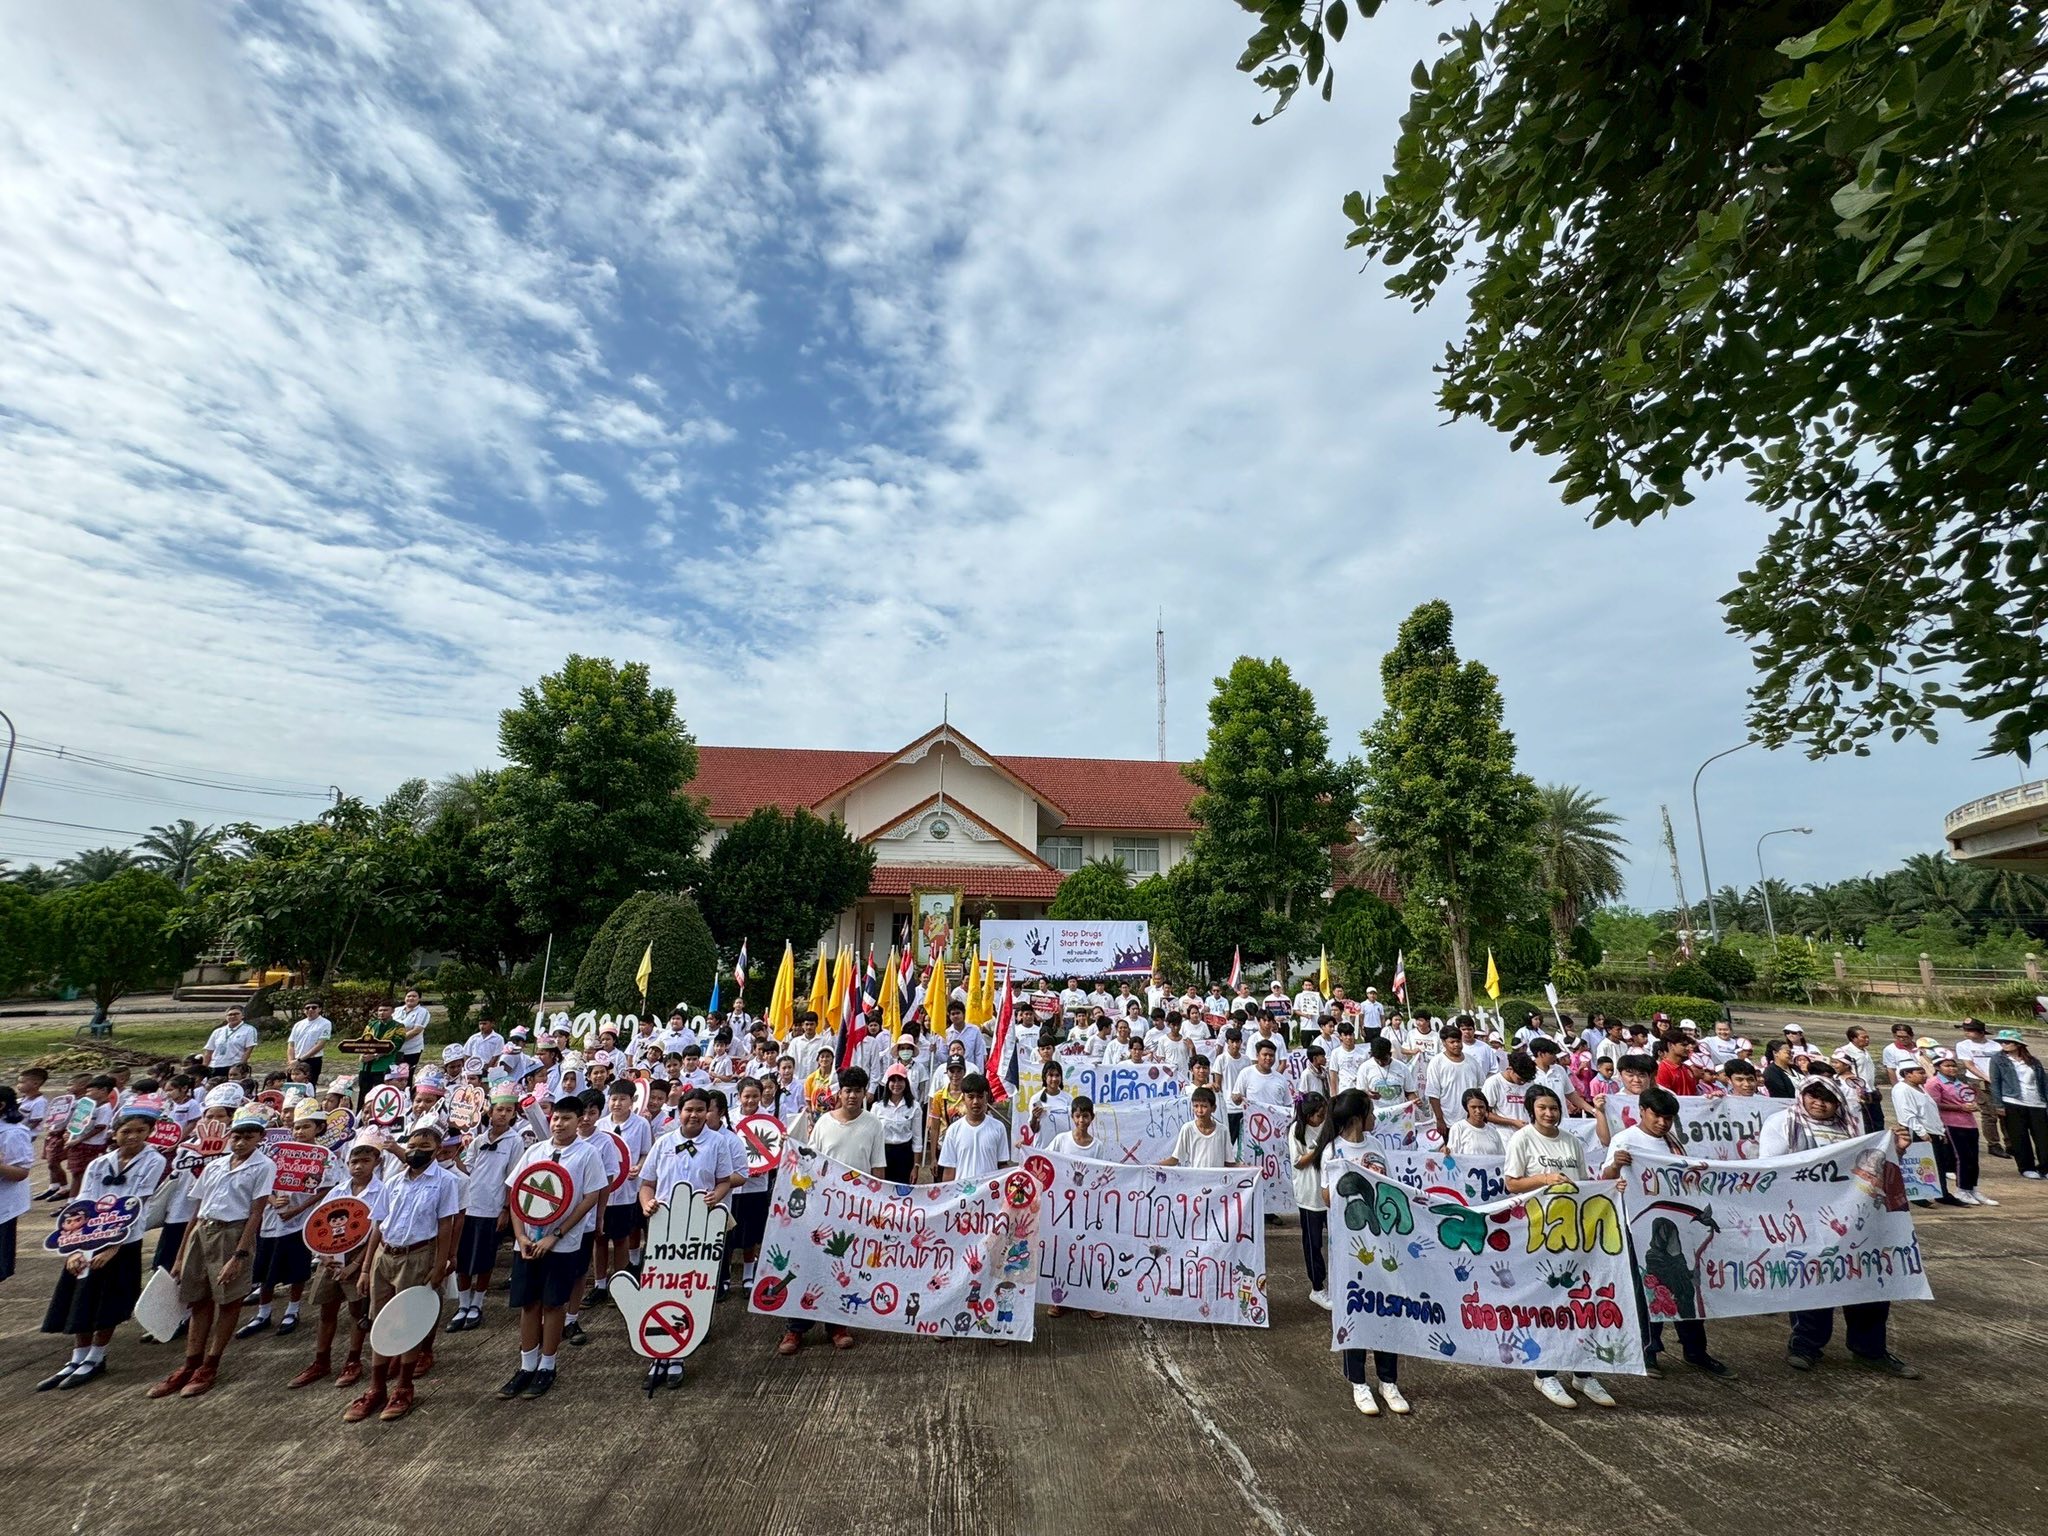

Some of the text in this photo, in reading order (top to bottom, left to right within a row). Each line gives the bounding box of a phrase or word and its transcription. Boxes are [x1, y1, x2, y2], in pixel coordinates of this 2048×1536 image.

[1061, 929, 1103, 939] Stop Drugs
[1060, 939, 1105, 947] Start Power
[201, 1140, 223, 1151] NO
[1336, 1171, 1415, 1236] ลด
[1525, 1180, 1623, 1255] เลิก
[1758, 1199, 1808, 1244] แต่
[850, 1237, 954, 1270] ยาเสพติด
[859, 1270, 872, 1282] NO
[876, 1292, 891, 1303] NO
[916, 1320, 939, 1334] NO
